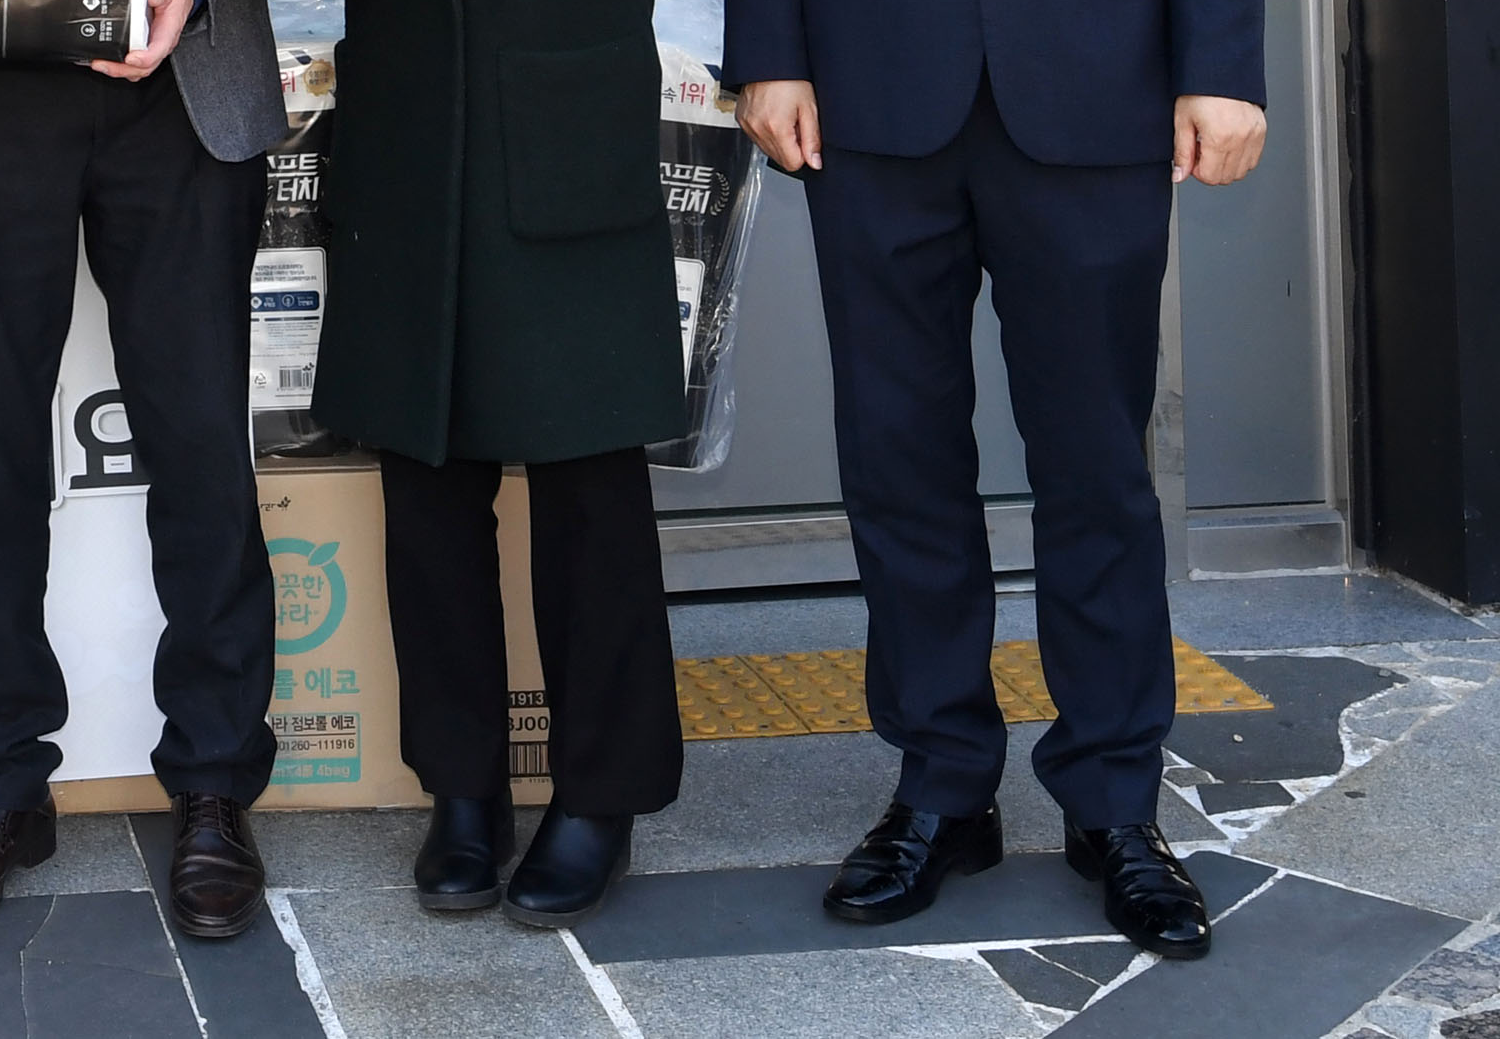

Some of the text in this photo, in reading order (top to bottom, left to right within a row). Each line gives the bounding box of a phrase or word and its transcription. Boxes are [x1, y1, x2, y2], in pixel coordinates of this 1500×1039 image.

[680, 80, 706, 106] 1위
[276, 176, 320, 203] 터치
[666, 186, 711, 215] 터치
[279, 573, 325, 600] 끗한
[304, 667, 360, 699] 에코
[291, 715, 327, 732] 점보롤
[331, 714, 356, 731] 에코
